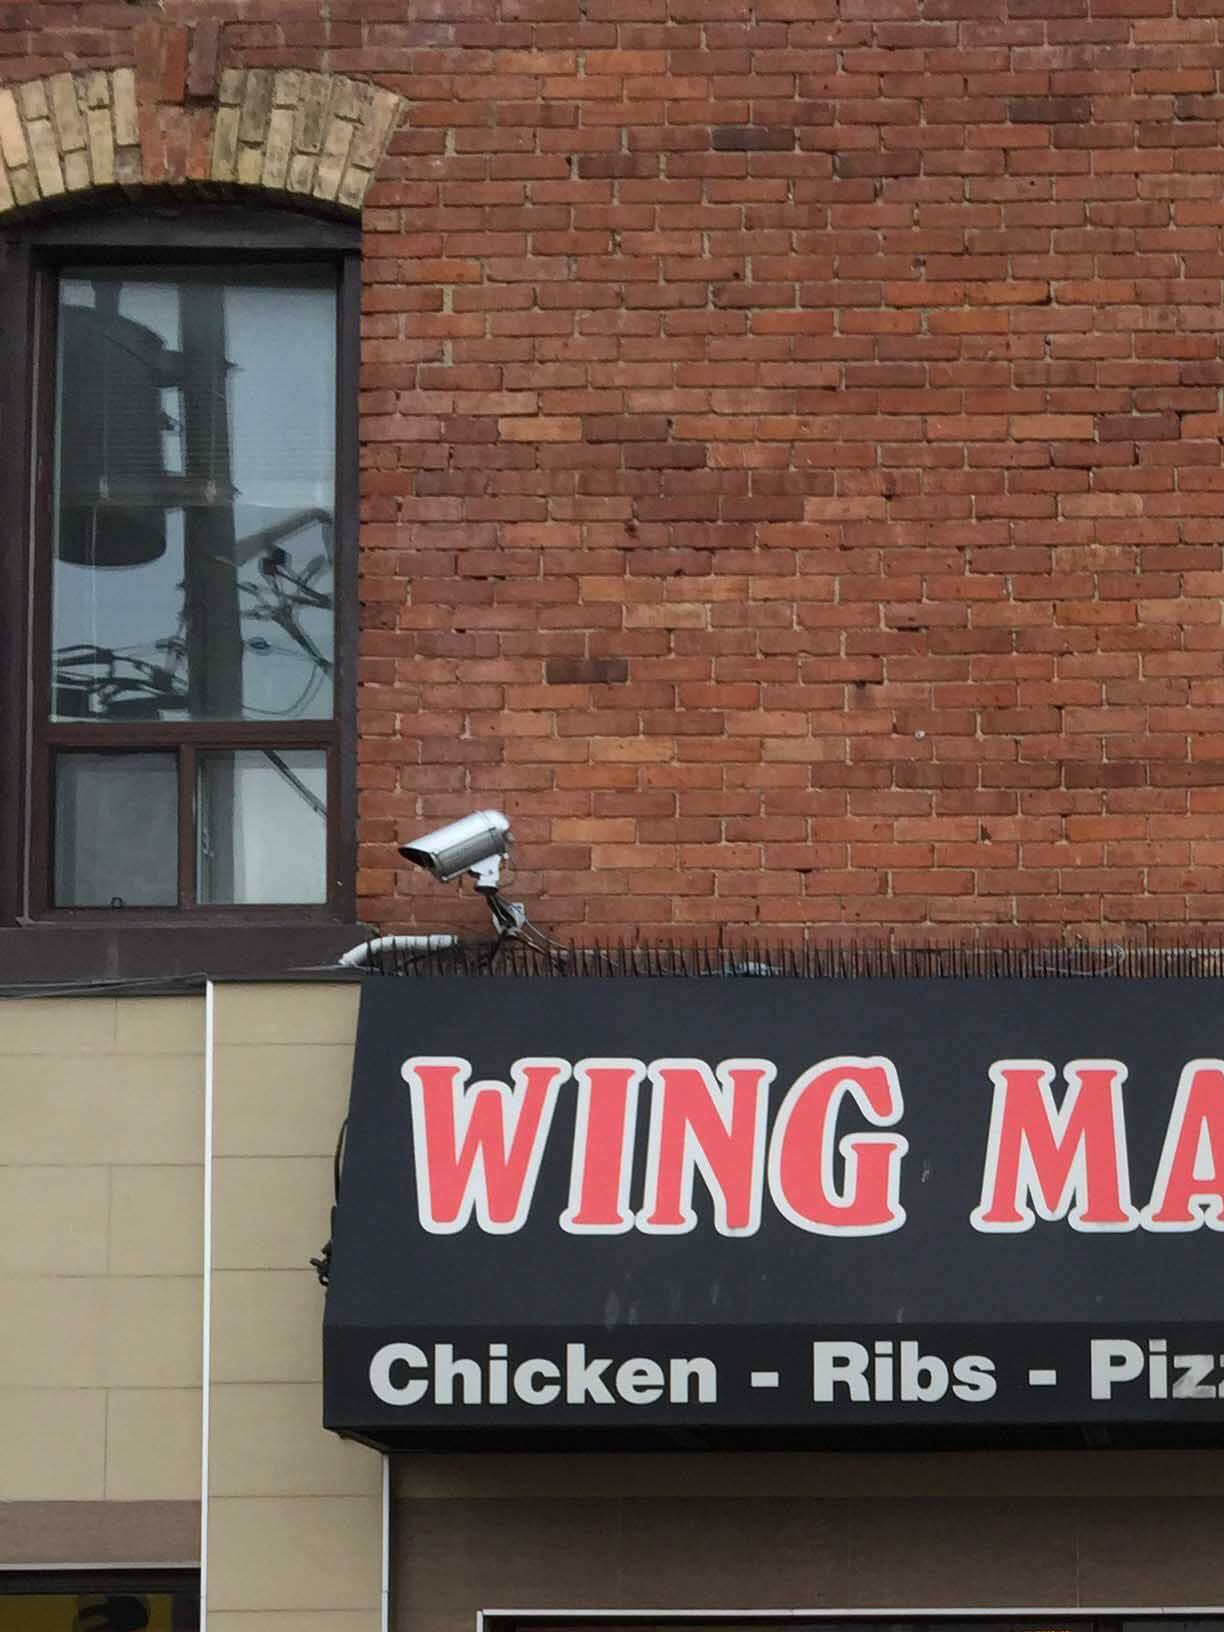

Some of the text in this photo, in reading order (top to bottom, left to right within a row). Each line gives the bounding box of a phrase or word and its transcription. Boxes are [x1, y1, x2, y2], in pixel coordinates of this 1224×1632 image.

[402, 1056, 908, 1236] WING
[369, 1342, 717, 1405] Chicken
[812, 1341, 997, 1402] Ribs
